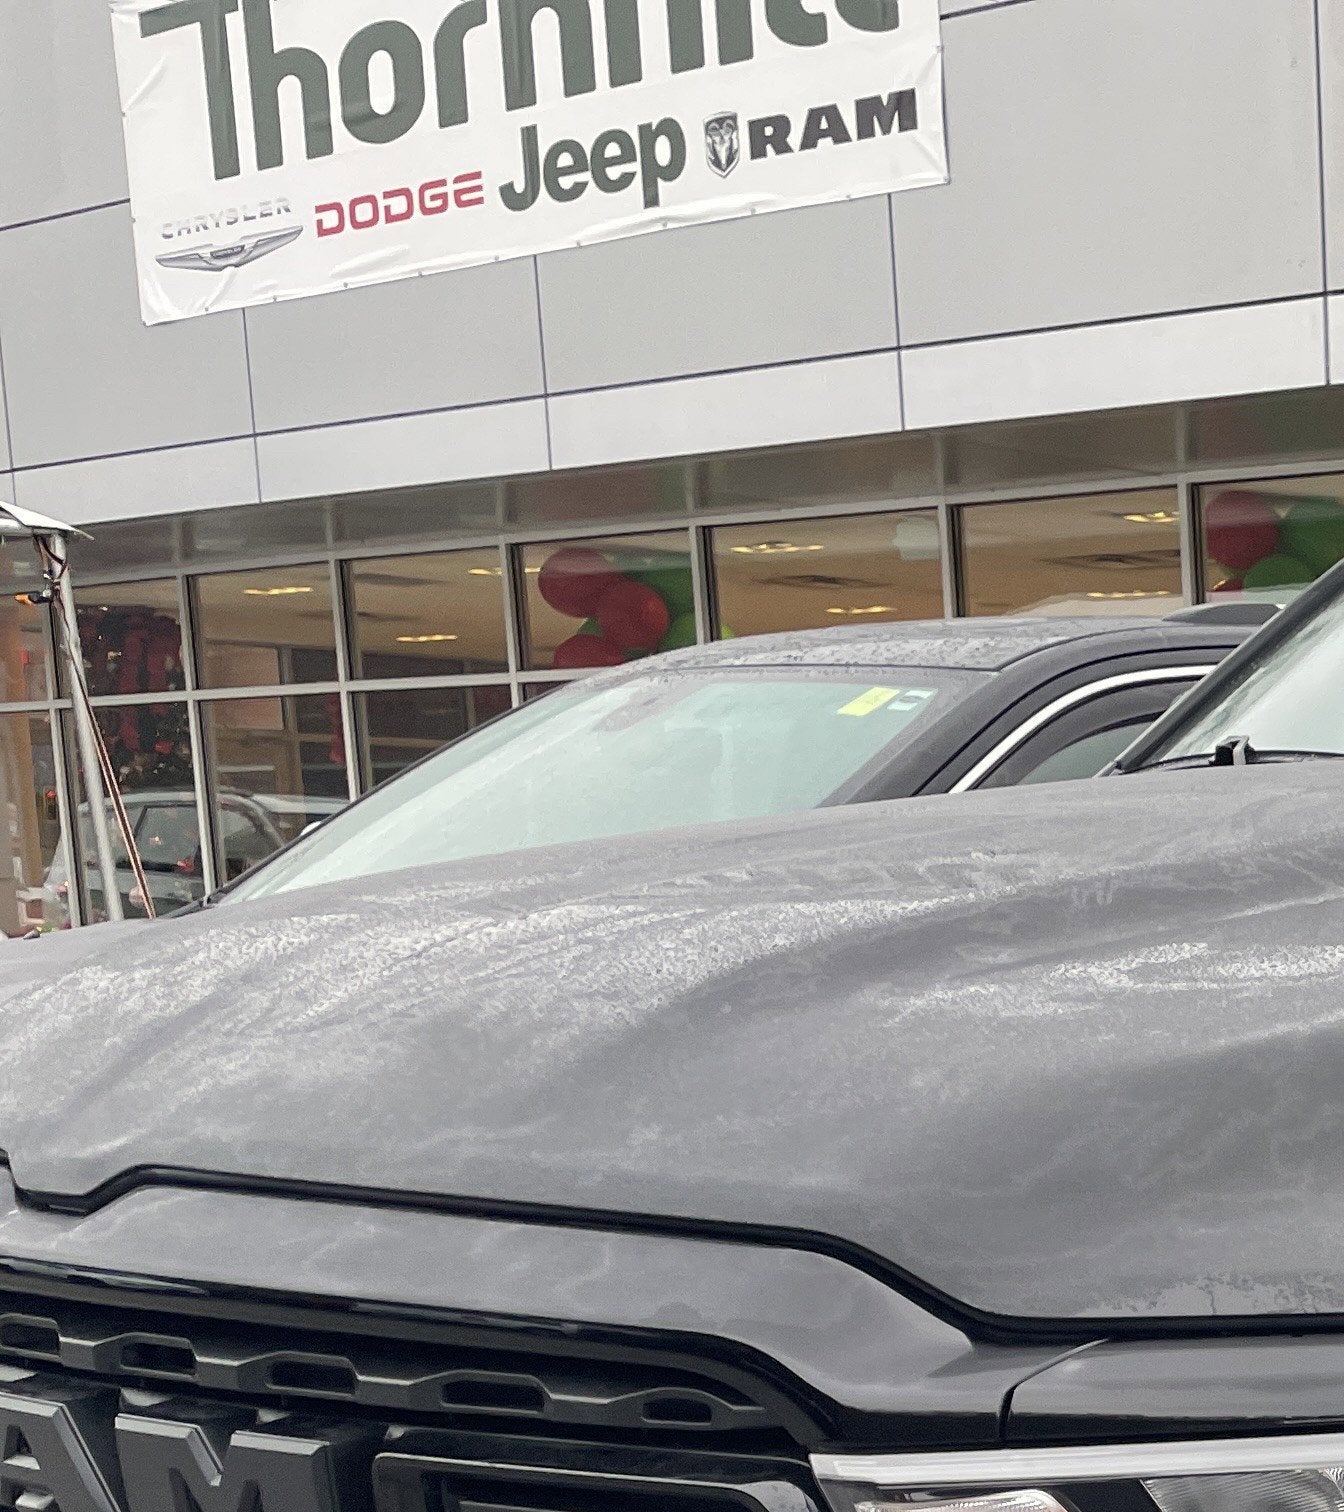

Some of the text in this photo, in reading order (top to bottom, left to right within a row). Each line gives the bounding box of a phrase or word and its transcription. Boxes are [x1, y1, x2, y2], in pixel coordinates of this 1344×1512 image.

[140, 0, 901, 181] Thorn
[162, 88, 918, 240] CHRYSLER DODGE Jeep RAM
